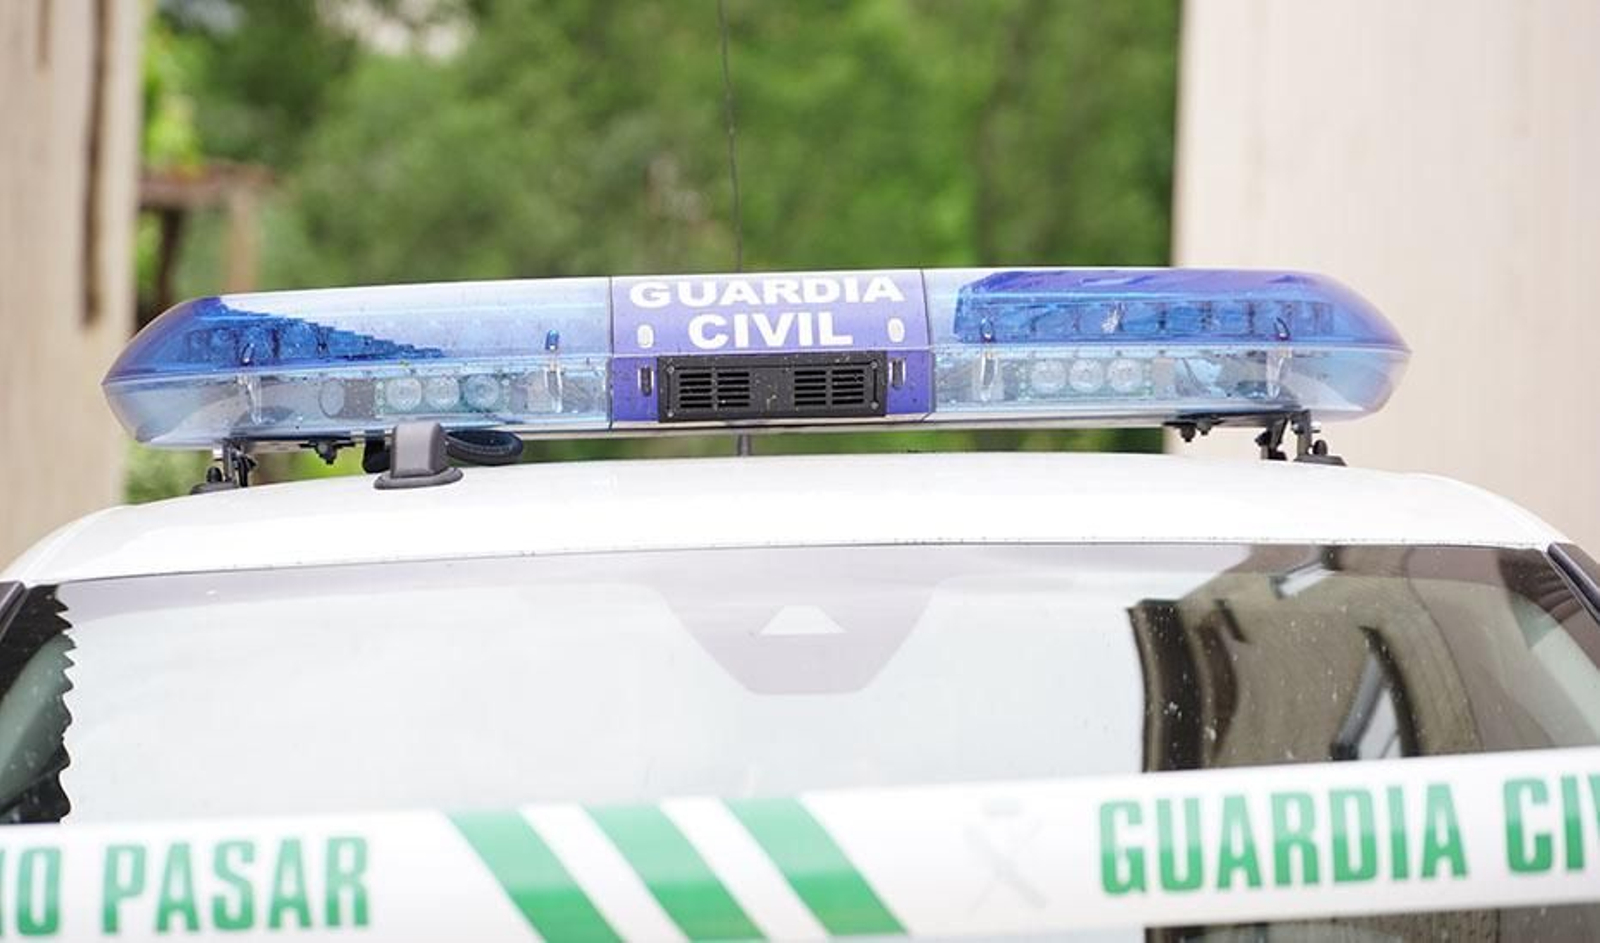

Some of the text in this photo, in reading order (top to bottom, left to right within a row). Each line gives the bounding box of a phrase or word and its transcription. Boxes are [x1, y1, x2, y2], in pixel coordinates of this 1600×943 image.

[629, 276, 904, 308] GUARDIA
[688, 311, 853, 349] CIVIL
[1099, 782, 1468, 896] GUARDIA
[0, 836, 369, 936] O PASAR
